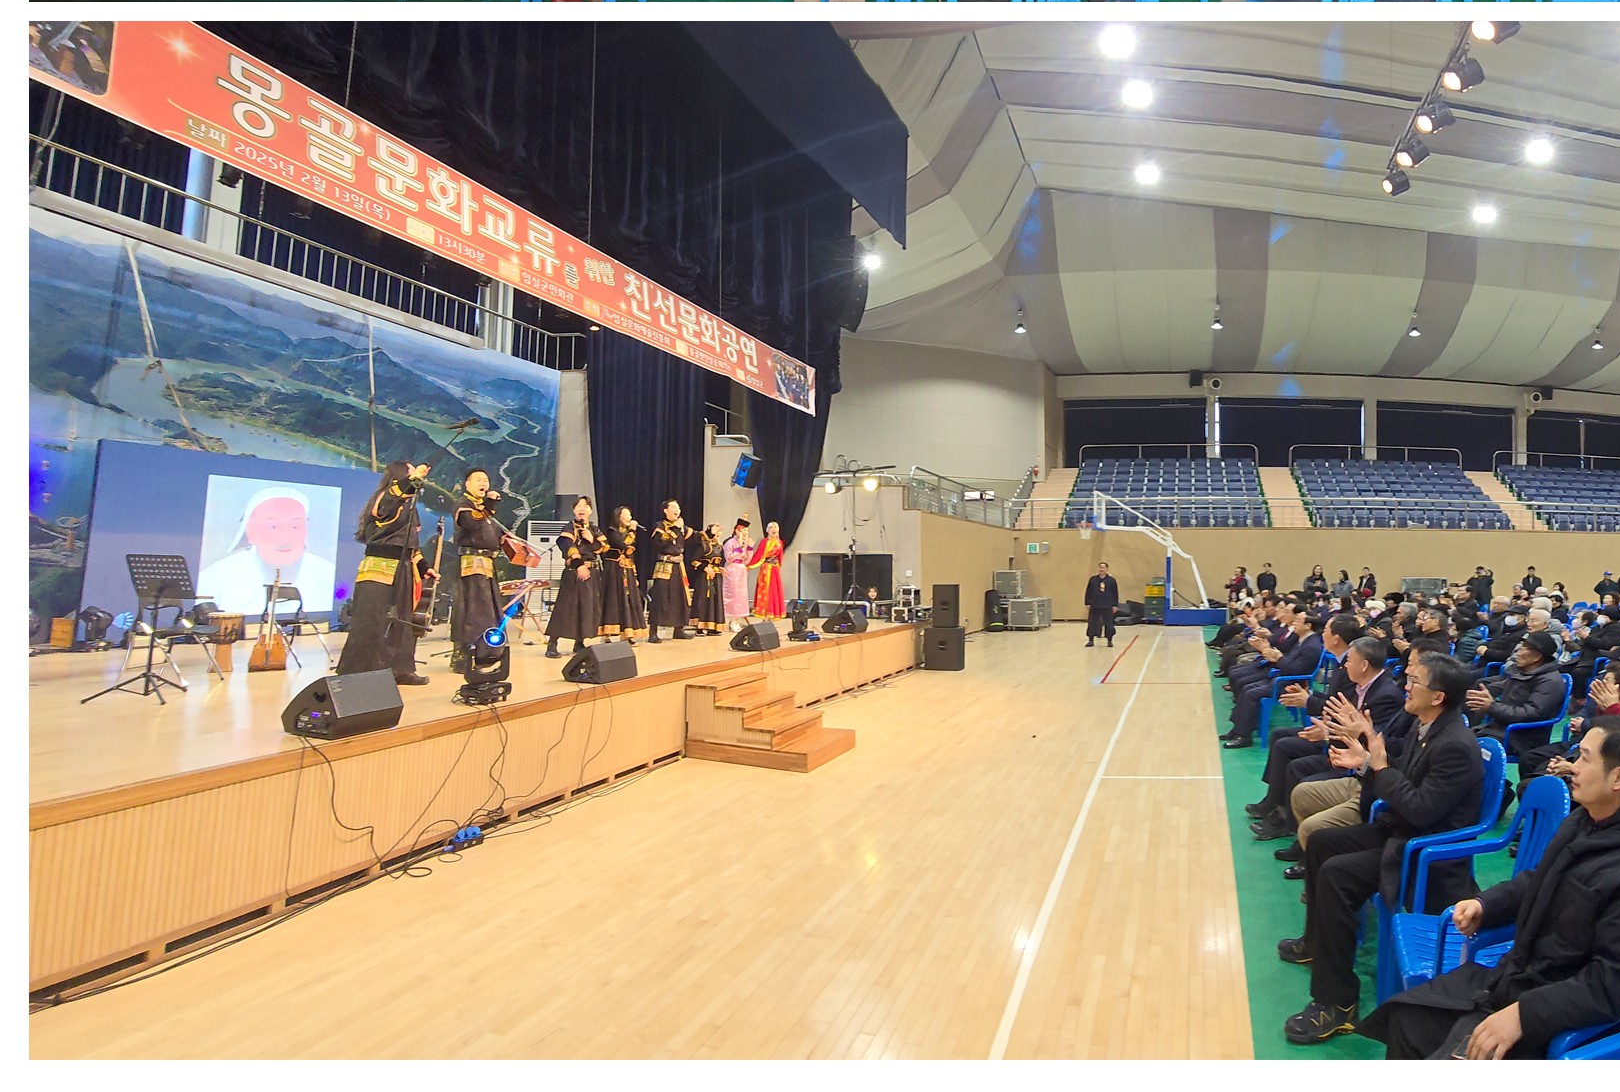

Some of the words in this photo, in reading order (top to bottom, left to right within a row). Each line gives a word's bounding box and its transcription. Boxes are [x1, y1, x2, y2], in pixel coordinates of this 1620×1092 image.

[187, 117, 228, 148] 날짜
[233, 140, 296, 180] 2025년
[300, 171, 327, 195] 2월
[334, 186, 391, 221] 13일(목)
[438, 234, 486, 265] 13시30분
[216, 52, 580, 290] 몽골문화교류를
[583, 257, 616, 287] 위한
[623, 272, 759, 375] 친선문화공연
